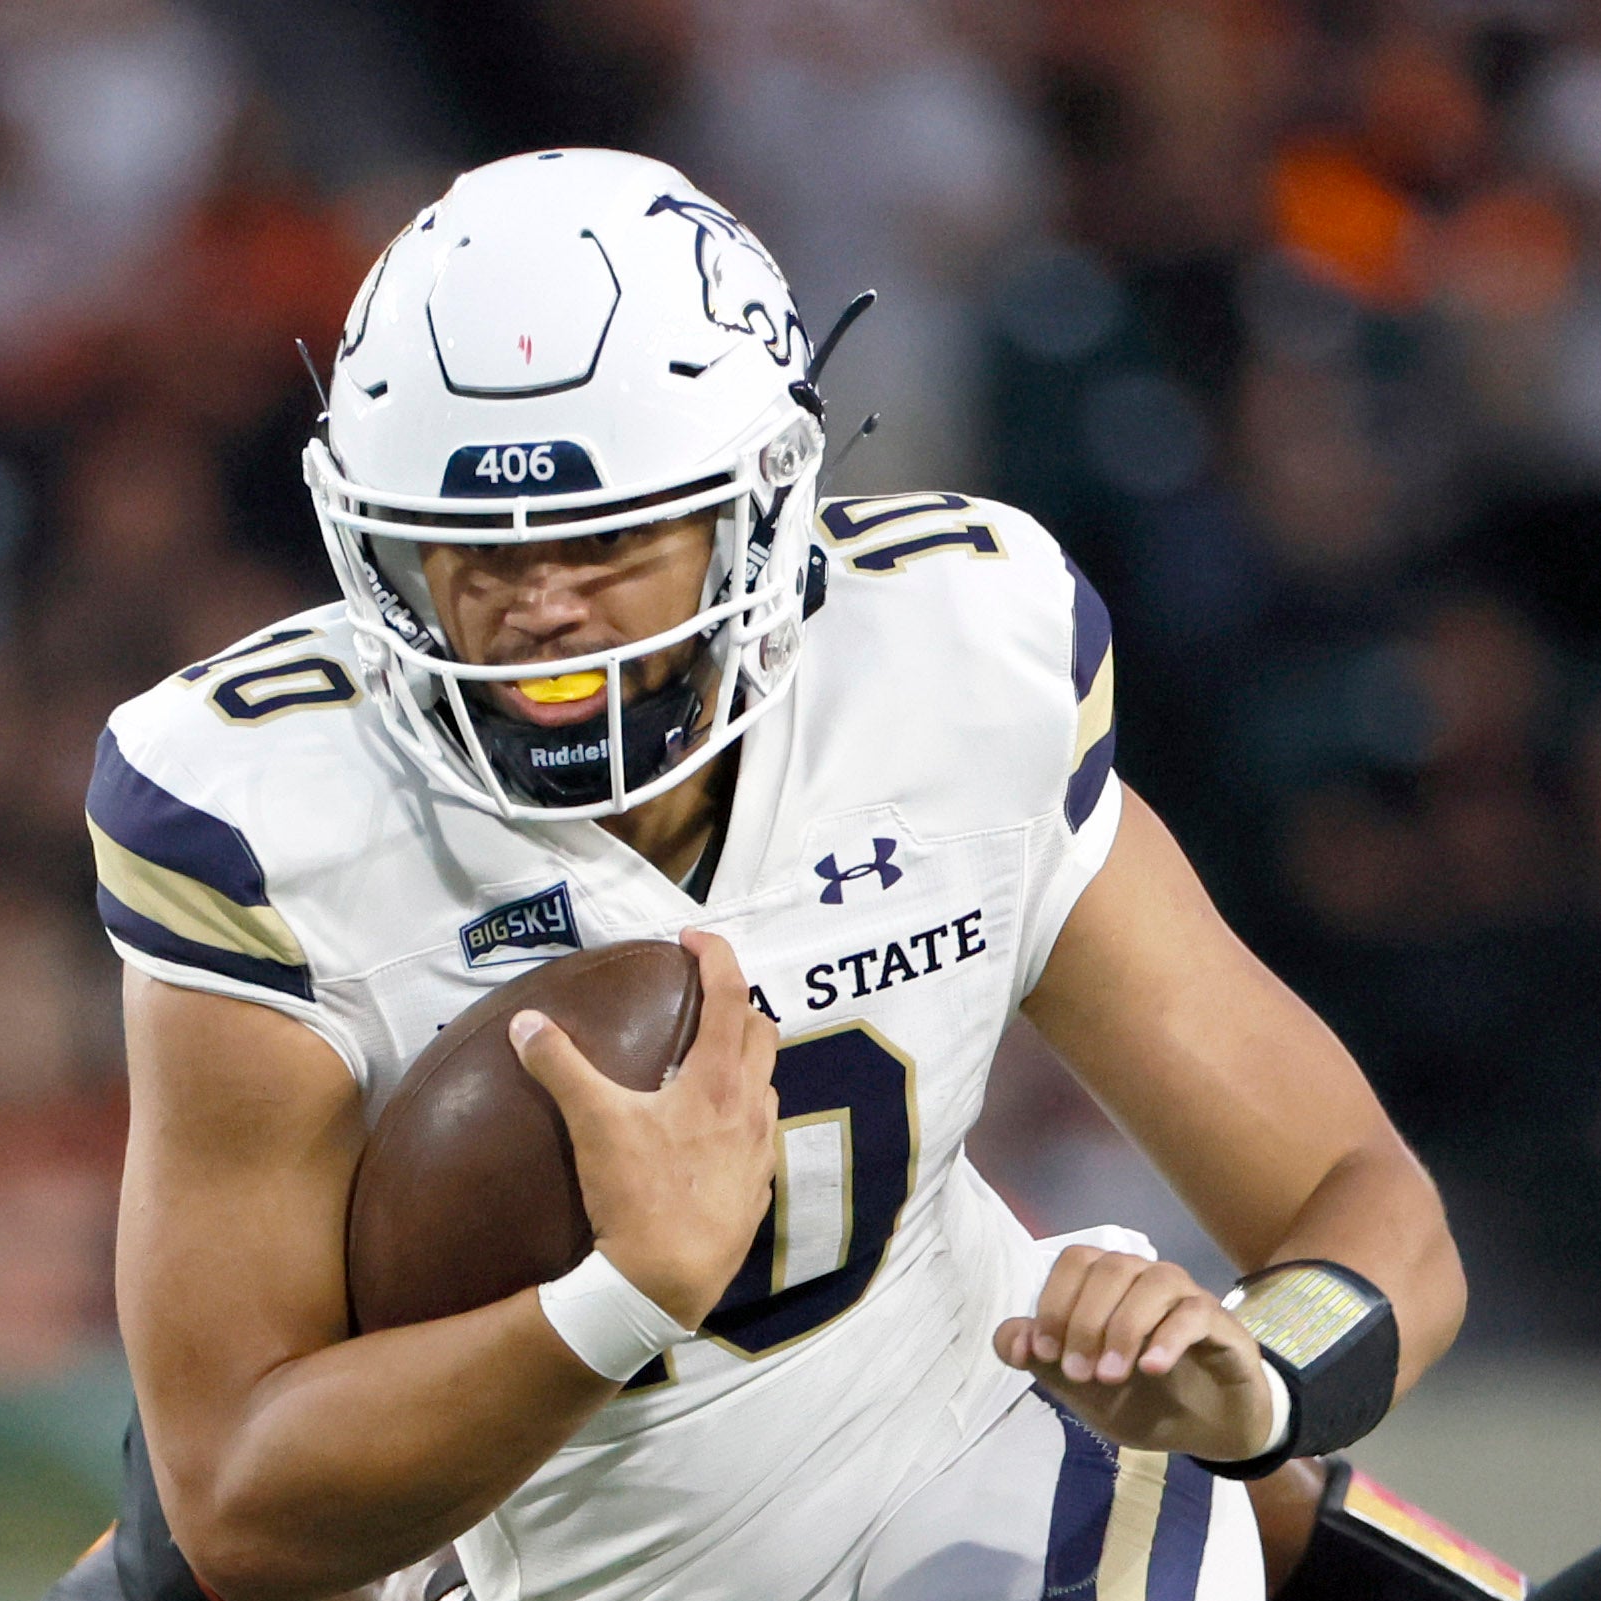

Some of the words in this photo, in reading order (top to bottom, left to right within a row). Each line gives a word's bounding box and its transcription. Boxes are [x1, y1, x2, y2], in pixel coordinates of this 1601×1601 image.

[475, 444, 556, 484] 406
[813, 491, 1010, 579] 10
[170, 626, 365, 729] 10
[530, 738, 611, 767] Riddel
[805, 908, 987, 1010] STATE
